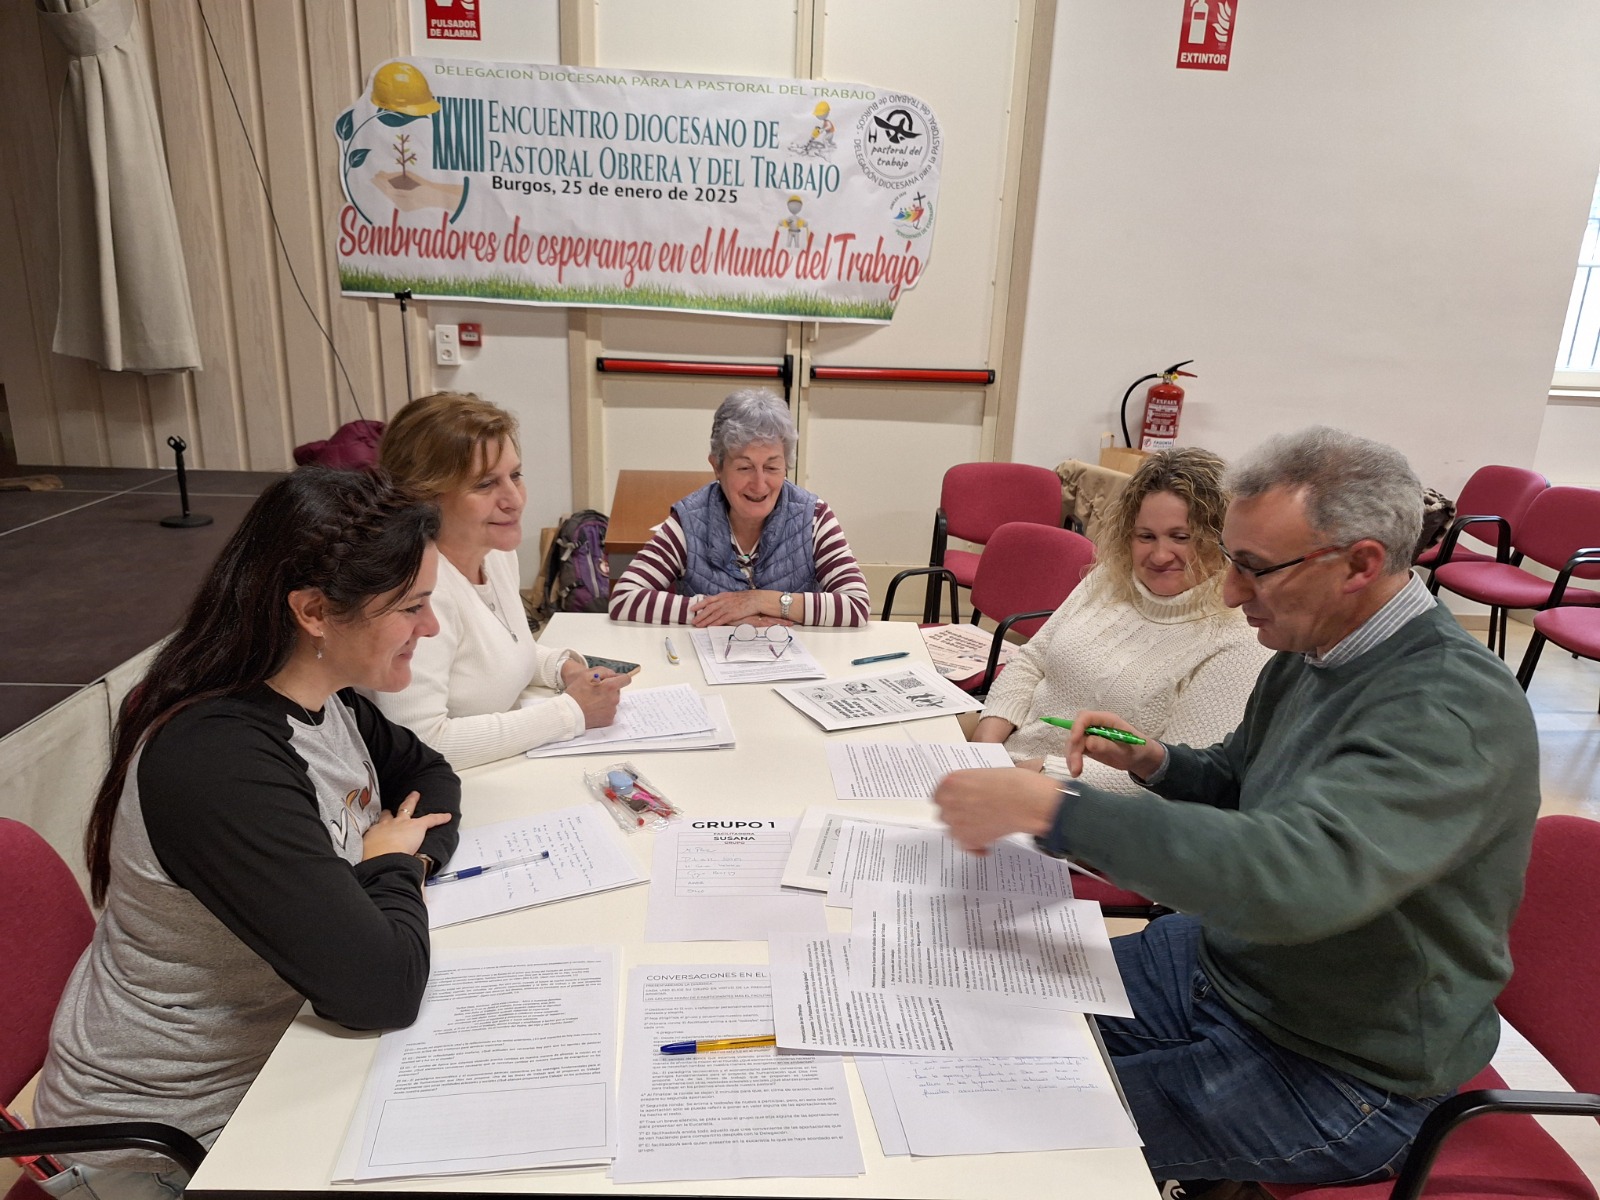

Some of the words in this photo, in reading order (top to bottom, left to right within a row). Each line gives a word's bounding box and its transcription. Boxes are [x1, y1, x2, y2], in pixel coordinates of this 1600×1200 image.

[431, 19, 476, 28] PULSADOR
[430, 28, 442, 36] DE
[443, 29, 478, 38] ALARMA
[1180, 52, 1227, 64] EXTINTOR
[539, 71, 627, 86] DIOCESANA
[632, 76, 670, 88] PARA
[674, 79, 692, 90] LA
[698, 80, 774, 94] PASTORAL
[779, 84, 808, 96] DEL
[811, 86, 876, 100] TRABAJO
[878, 96, 888, 106] de
[888, 94, 920, 109] TRABAJO
[856, 102, 880, 130] BURGOS
[920, 102, 932, 116] del
[753, 120, 780, 150] DE
[928, 114, 940, 156] PASTORAL
[870, 146, 908, 157] pastoral
[909, 146, 922, 156] del
[876, 158, 909, 170] trabajo
[928, 156, 937, 166] la
[688, 156, 702, 184] Y
[708, 157, 745, 188] DEL
[918, 164, 932, 182] para
[492, 176, 556, 196] Burgos,
[562, 180, 582, 195] 25
[589, 181, 610, 197] de
[614, 186, 663, 200] enero
[668, 186, 688, 201] de
[694, 188, 738, 204] 2025
[878, 176, 920, 190] DIOCESANA
[340, 204, 498, 263] Sembradores
[504, 216, 533, 264] de
[536, 234, 655, 288] esperanza
[658, 242, 687, 274] en
[690, 226, 712, 275] el
[714, 227, 793, 280] Mundo
[796, 232, 832, 280] del
[834, 232, 922, 301] Trabajo
[692, 821, 762, 829] GRUPO
[646, 972, 737, 981] CONVERSACIONES
